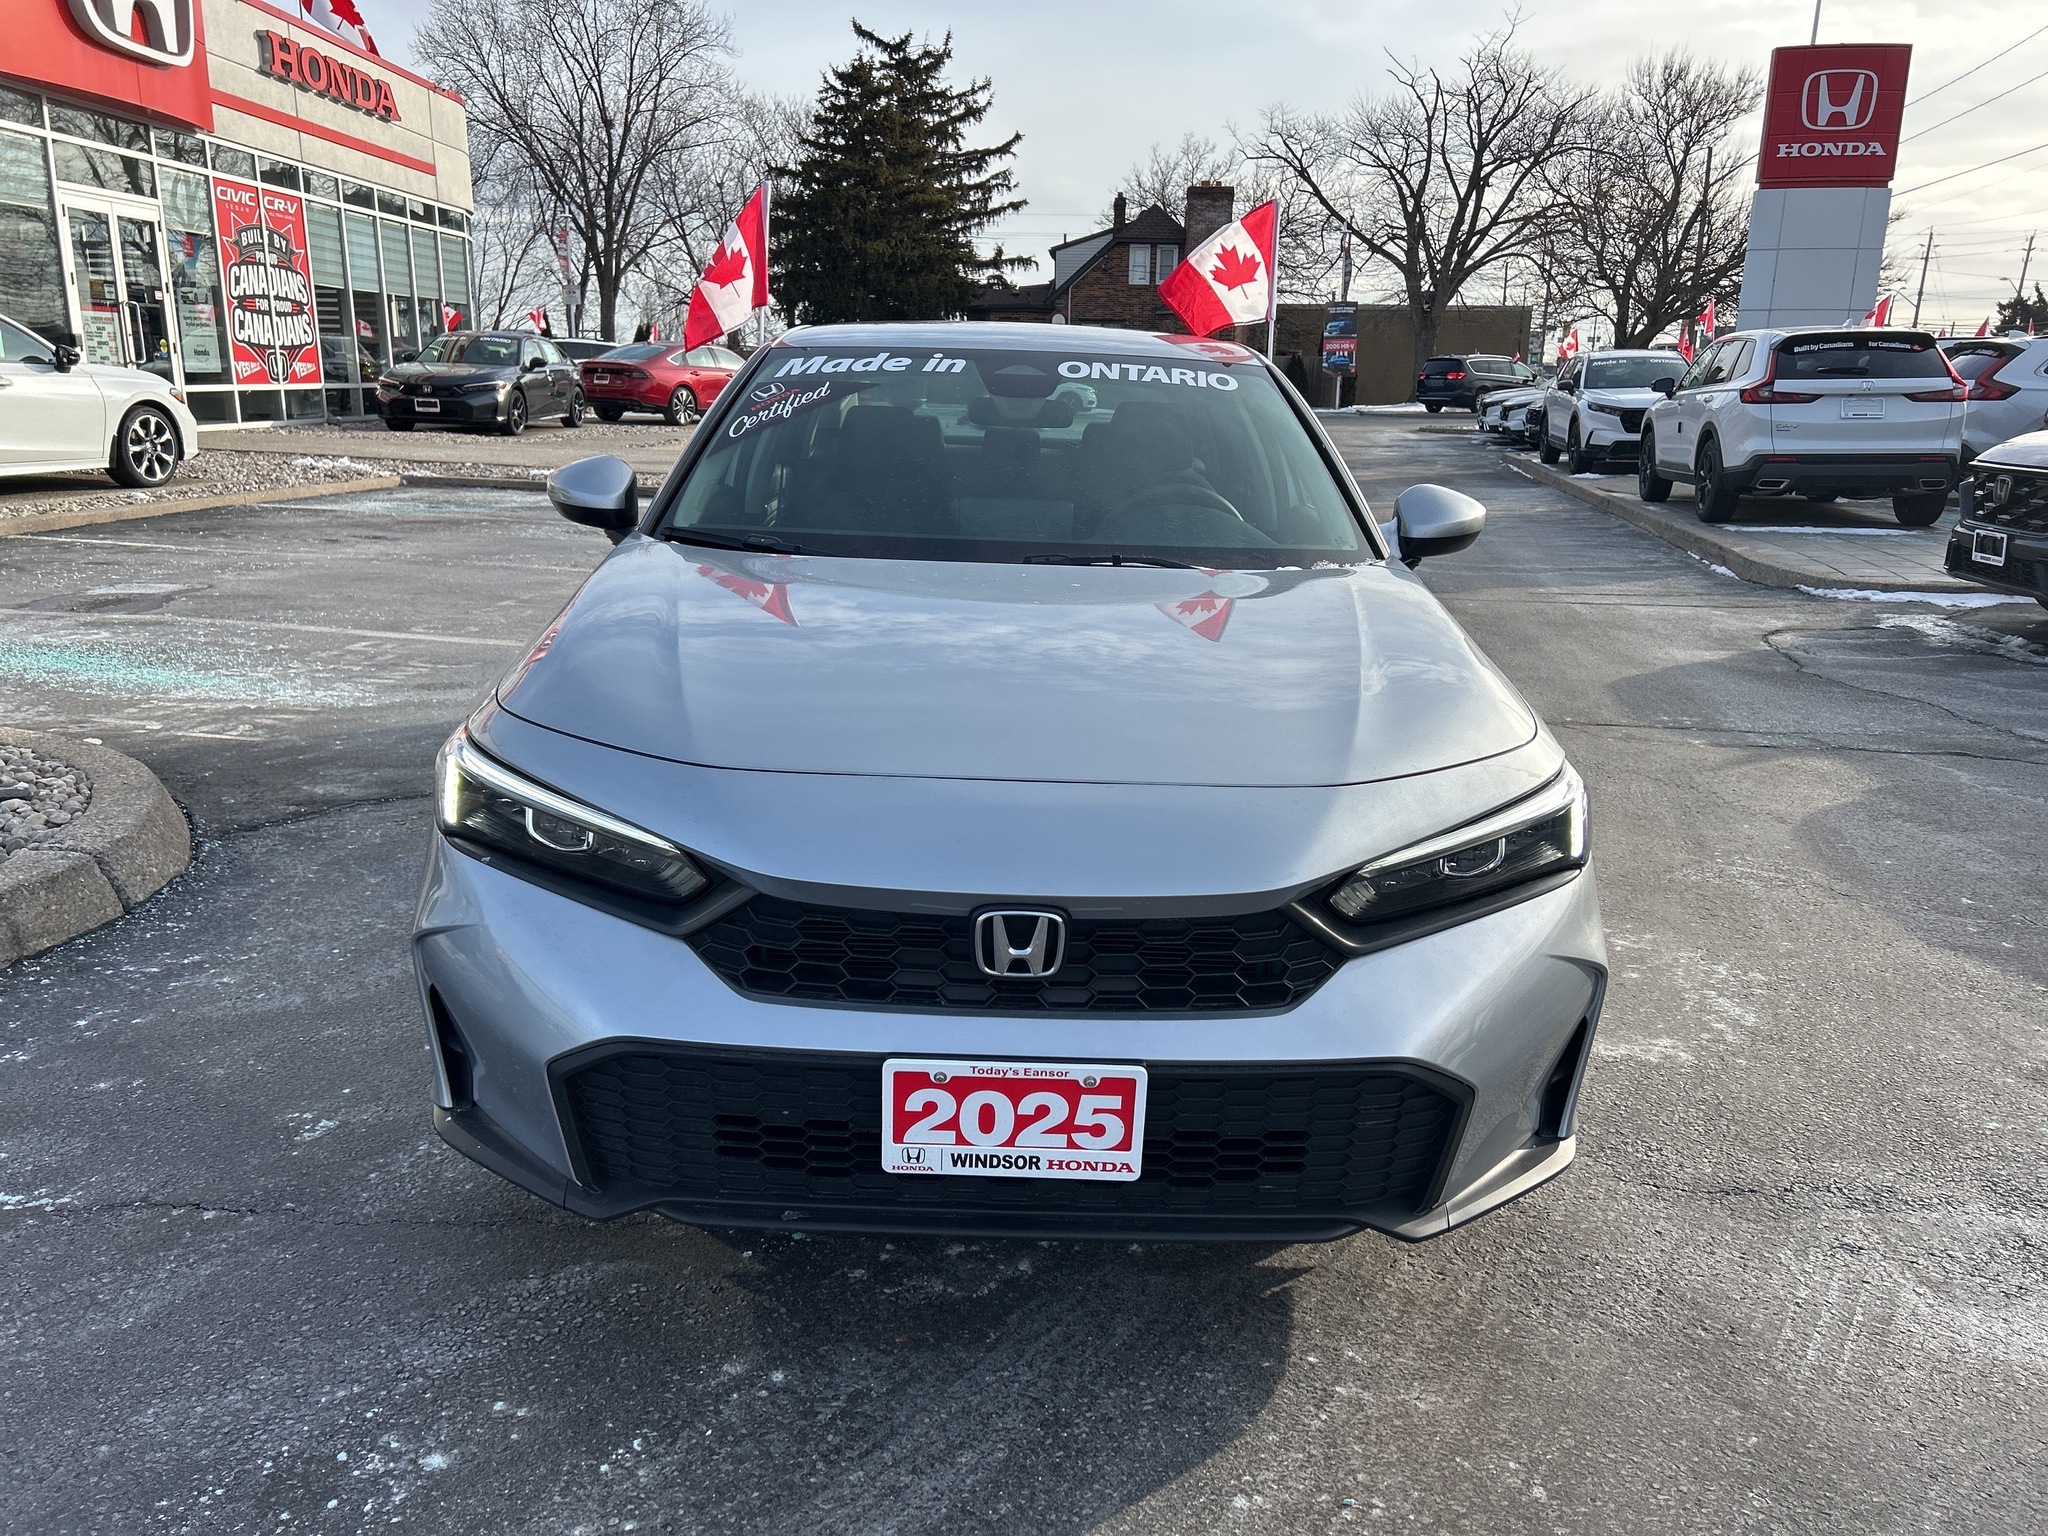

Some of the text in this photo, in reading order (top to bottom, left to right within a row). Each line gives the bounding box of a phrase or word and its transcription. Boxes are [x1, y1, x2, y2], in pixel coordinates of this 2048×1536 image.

[264, 29, 402, 122] HONDA
[1776, 142, 1886, 157] HONDA
[216, 185, 256, 207] CIVIC
[263, 195, 298, 214] CR-V
[225, 203, 250, 213] SEDAN
[273, 233, 287, 253] BY
[230, 264, 308, 304] CANADIANS
[255, 298, 270, 311] FOR
[234, 308, 313, 346] CANADIANS
[1794, 345, 1810, 353] Built
[1819, 341, 1854, 349] Canadians
[1878, 341, 1911, 349] Canadians
[774, 352, 1239, 391] Made in ONTARIO
[728, 381, 831, 438] Certified
[750, 387, 801, 412] HONDA
[970, 1066, 1070, 1078] Today's Eansor
[902, 1088, 1125, 1150] 2025
[950, 1152, 1135, 1173] WINDSOR HONDA
